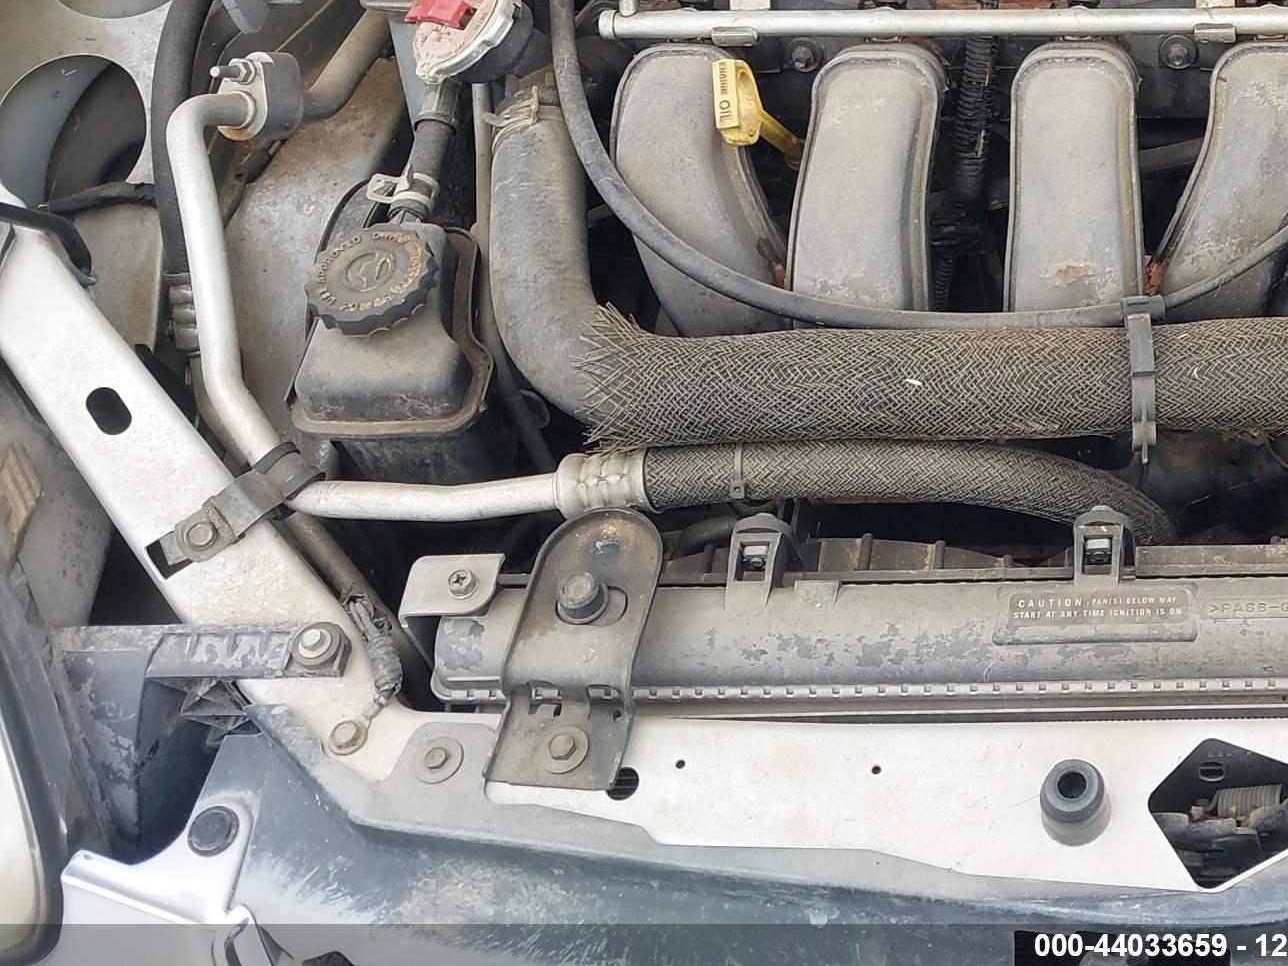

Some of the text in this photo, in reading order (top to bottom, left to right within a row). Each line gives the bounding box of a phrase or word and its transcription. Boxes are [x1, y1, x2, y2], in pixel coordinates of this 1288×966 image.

[719, 62, 729, 95] ENGINE
[719, 100, 733, 122] OIL
[1018, 599, 1082, 608] CAUTION
[1126, 597, 1154, 605] BELOW
[1159, 596, 1177, 604] MAY
[1060, 610, 1078, 618] ANY
[1082, 609, 1105, 617] TIME
[1109, 608, 1151, 616] IGNITION
[1169, 607, 1182, 615] ON
